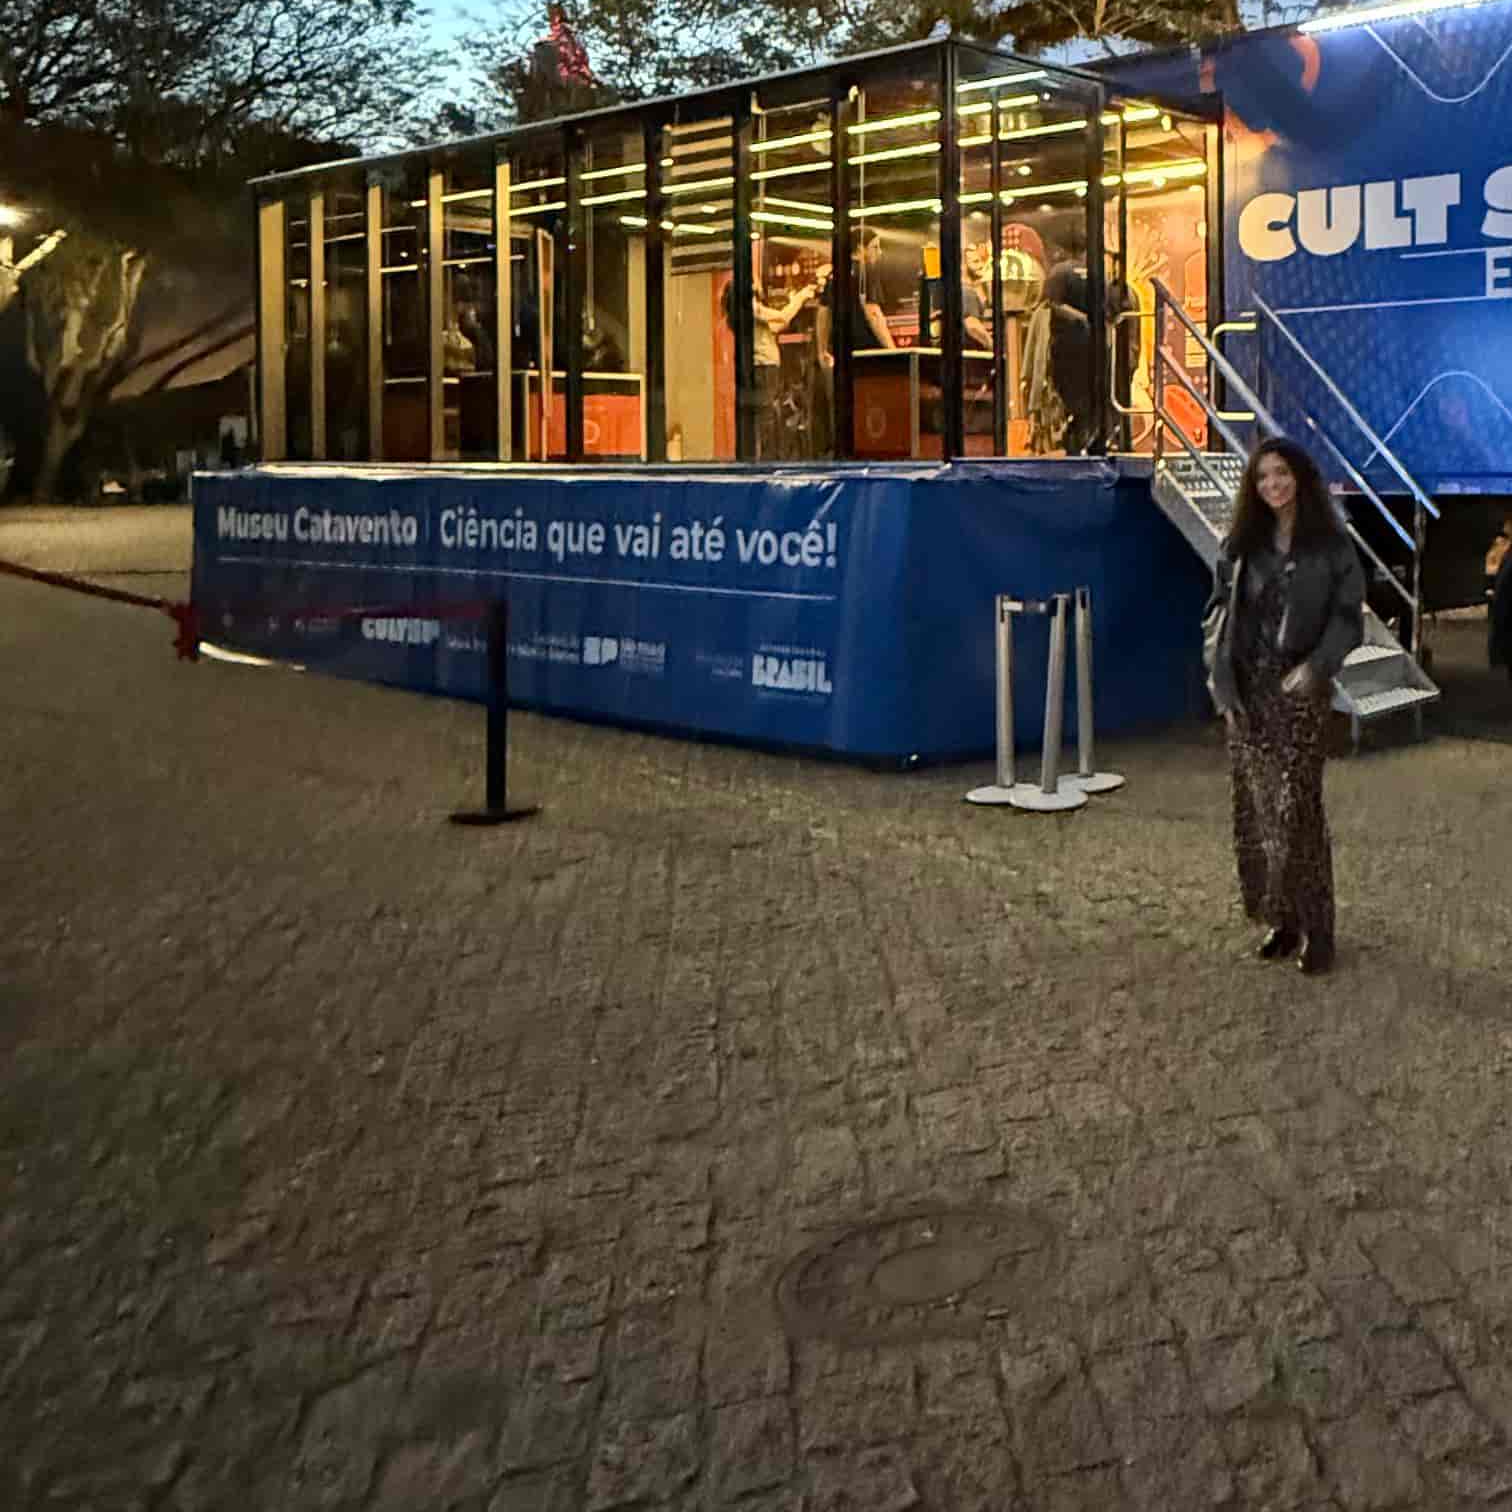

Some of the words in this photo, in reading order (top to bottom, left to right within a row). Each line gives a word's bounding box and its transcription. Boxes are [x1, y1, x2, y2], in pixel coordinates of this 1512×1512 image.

[1238, 173, 1461, 262] CULT
[217, 505, 289, 539] Museu
[294, 506, 418, 545] Catavento
[440, 505, 538, 551] Ciência
[547, 519, 606, 563] que
[614, 511, 662, 559] vai
[669, 515, 725, 562] até
[736, 520, 838, 568] você!
